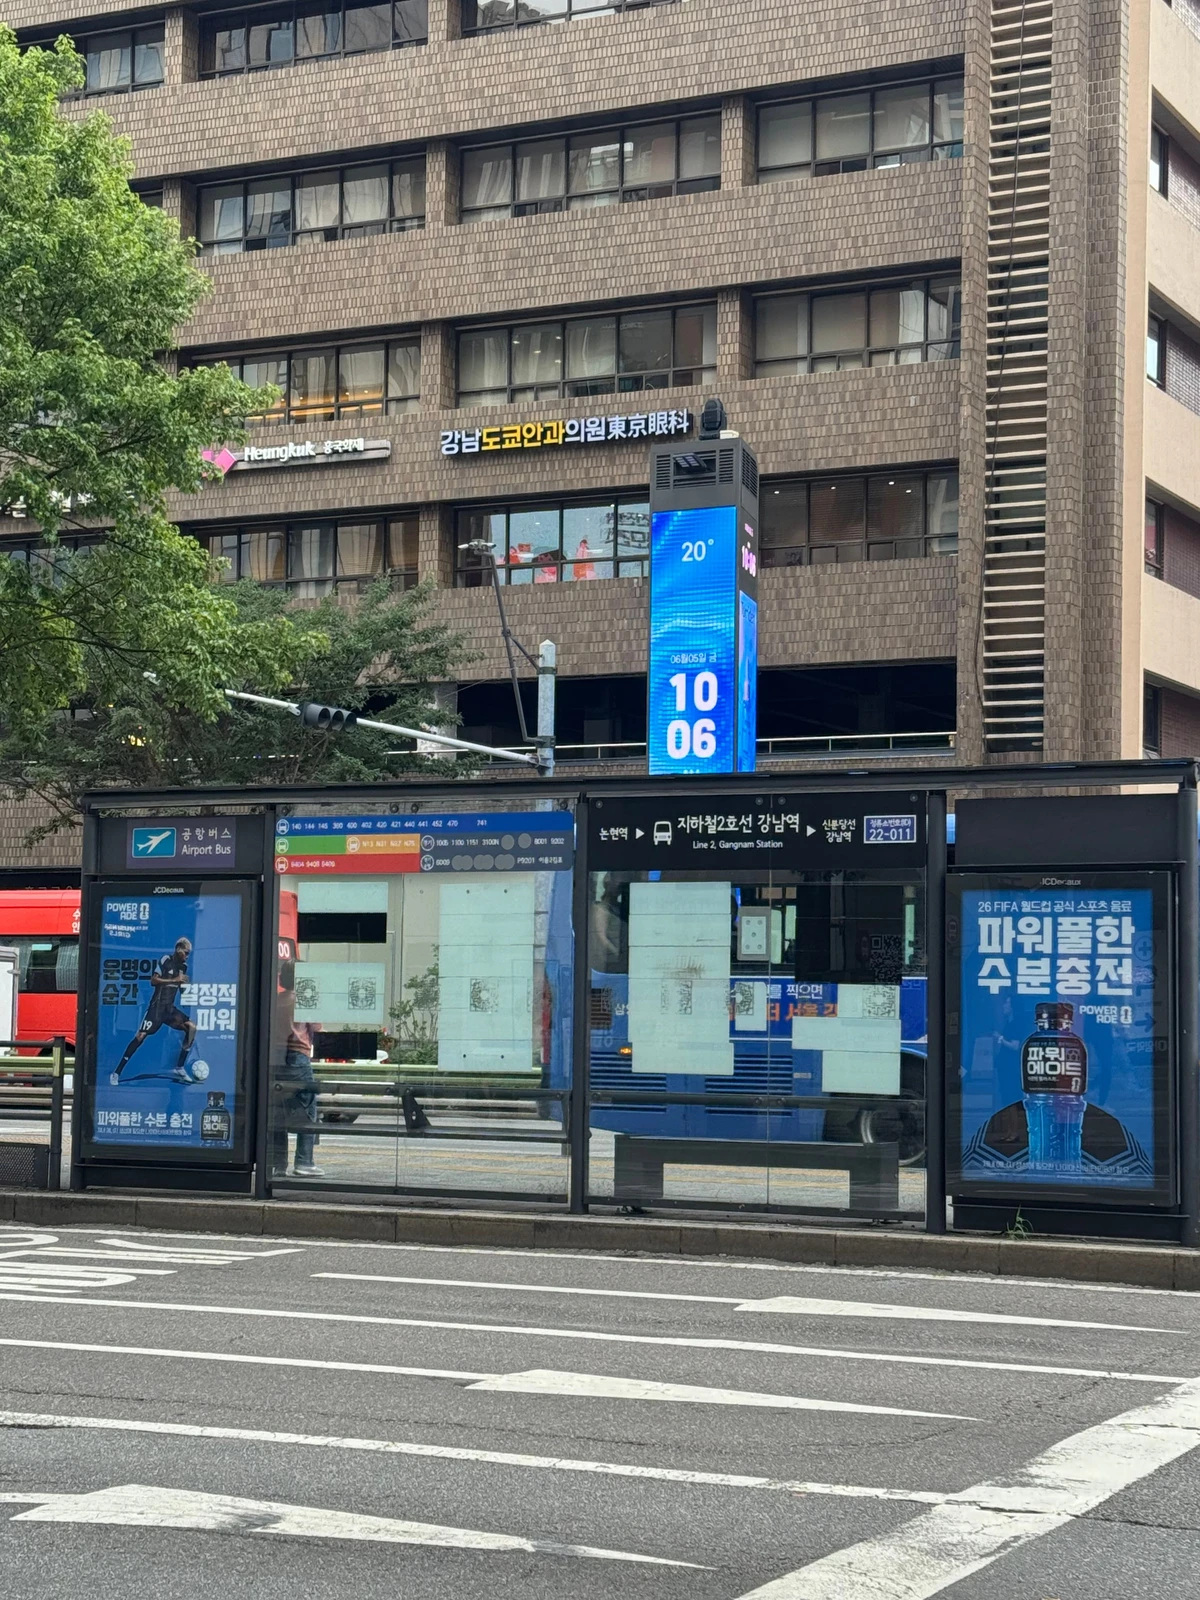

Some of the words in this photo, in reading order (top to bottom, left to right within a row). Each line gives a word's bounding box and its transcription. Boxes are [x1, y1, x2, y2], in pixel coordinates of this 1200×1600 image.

[244, 440, 316, 463] Heungkuk
[322, 437, 364, 455] 흥국화재
[669, 671, 718, 712] 10
[666, 718, 717, 760] 06
[346, 821, 358, 829] 400
[361, 821, 372, 829] 402
[447, 819, 459, 827] 470
[677, 813, 753, 834] 지하철2호선
[757, 813, 800, 833] 강남역
[822, 818, 856, 831] 신분당선
[181, 827, 232, 841] 공항버스
[599, 827, 628, 841] 논현역
[826, 831, 852, 843] 강남역
[869, 828, 911, 841] 22-011
[181, 844, 213, 857] Airport
[215, 844, 231, 855] Bus
[692, 841, 709, 849] Line
[710, 841, 717, 849] 2,
[719, 841, 754, 851] Gangnam
[756, 840, 783, 848] Station
[153, 886, 185, 894] JCDecaux
[106, 903, 138, 912] POWER
[977, 901, 992, 913] 26
[994, 901, 1019, 913] FIFA
[1020, 900, 1051, 913] 월드컵
[1053, 900, 1075, 913] 공식
[1076, 900, 1109, 913] 스포츠
[1110, 900, 1132, 913] 음료
[119, 912, 138, 921] ADE
[977, 916, 1136, 955] 파워풀한
[102, 959, 157, 981] 운명의
[102, 983, 139, 1006] 순간
[180, 983, 237, 1006] 결정적
[786, 983, 824, 1000] 찍으면
[1079, 1005, 1118, 1015] POWER
[142, 1020, 153, 1031] 19
[196, 1009, 236, 1032] 파워
[1096, 1014, 1118, 1024] ADE
[1027, 1061, 1082, 1076] 에이드
[97, 1111, 142, 1127] 파워풀한
[144, 1112, 168, 1127] 수분
[169, 1113, 193, 1129] 충전
